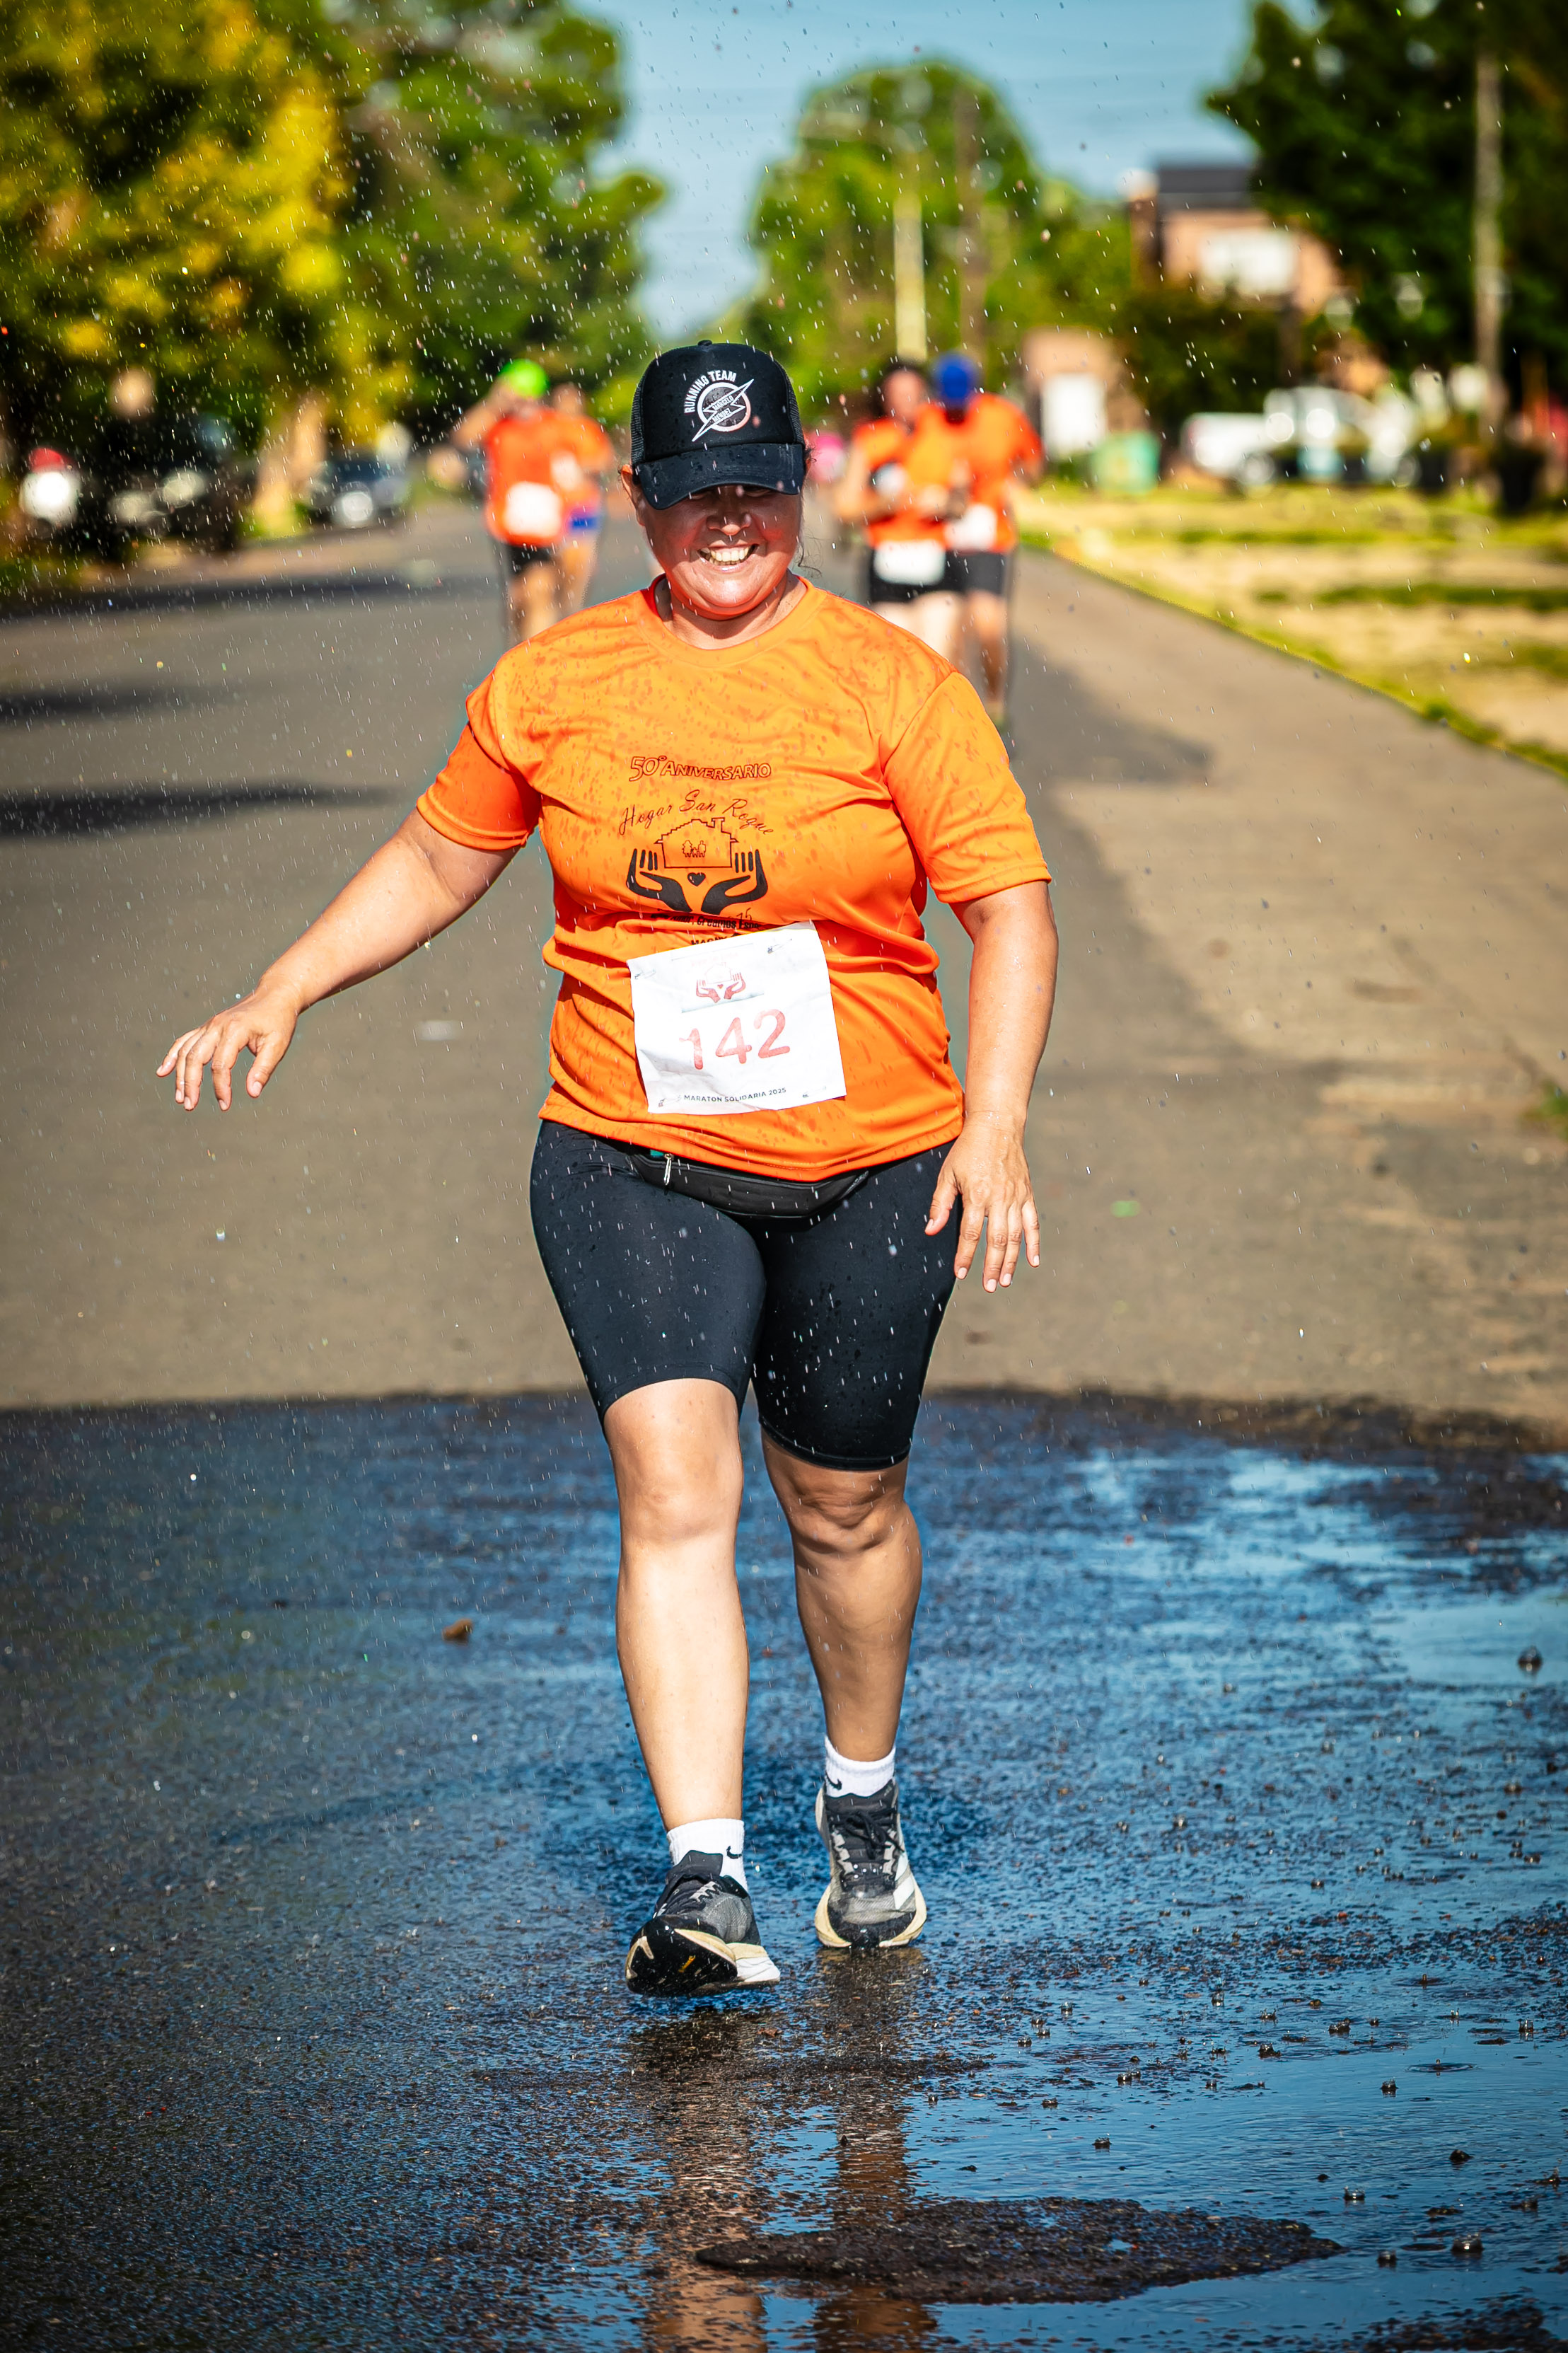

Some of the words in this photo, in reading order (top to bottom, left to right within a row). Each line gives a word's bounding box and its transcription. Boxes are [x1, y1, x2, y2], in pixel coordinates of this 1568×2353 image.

[684, 375, 709, 414] RUNNING
[707, 370, 737, 382] TEAM
[712, 395, 734, 410] MARCELO
[619, 804, 673, 836] Hogar
[680, 789, 716, 813] San
[679, 1009, 791, 1070] 142
[724, 1092, 767, 1102] SOLIDARIA
[768, 1087, 786, 1095] 2025
